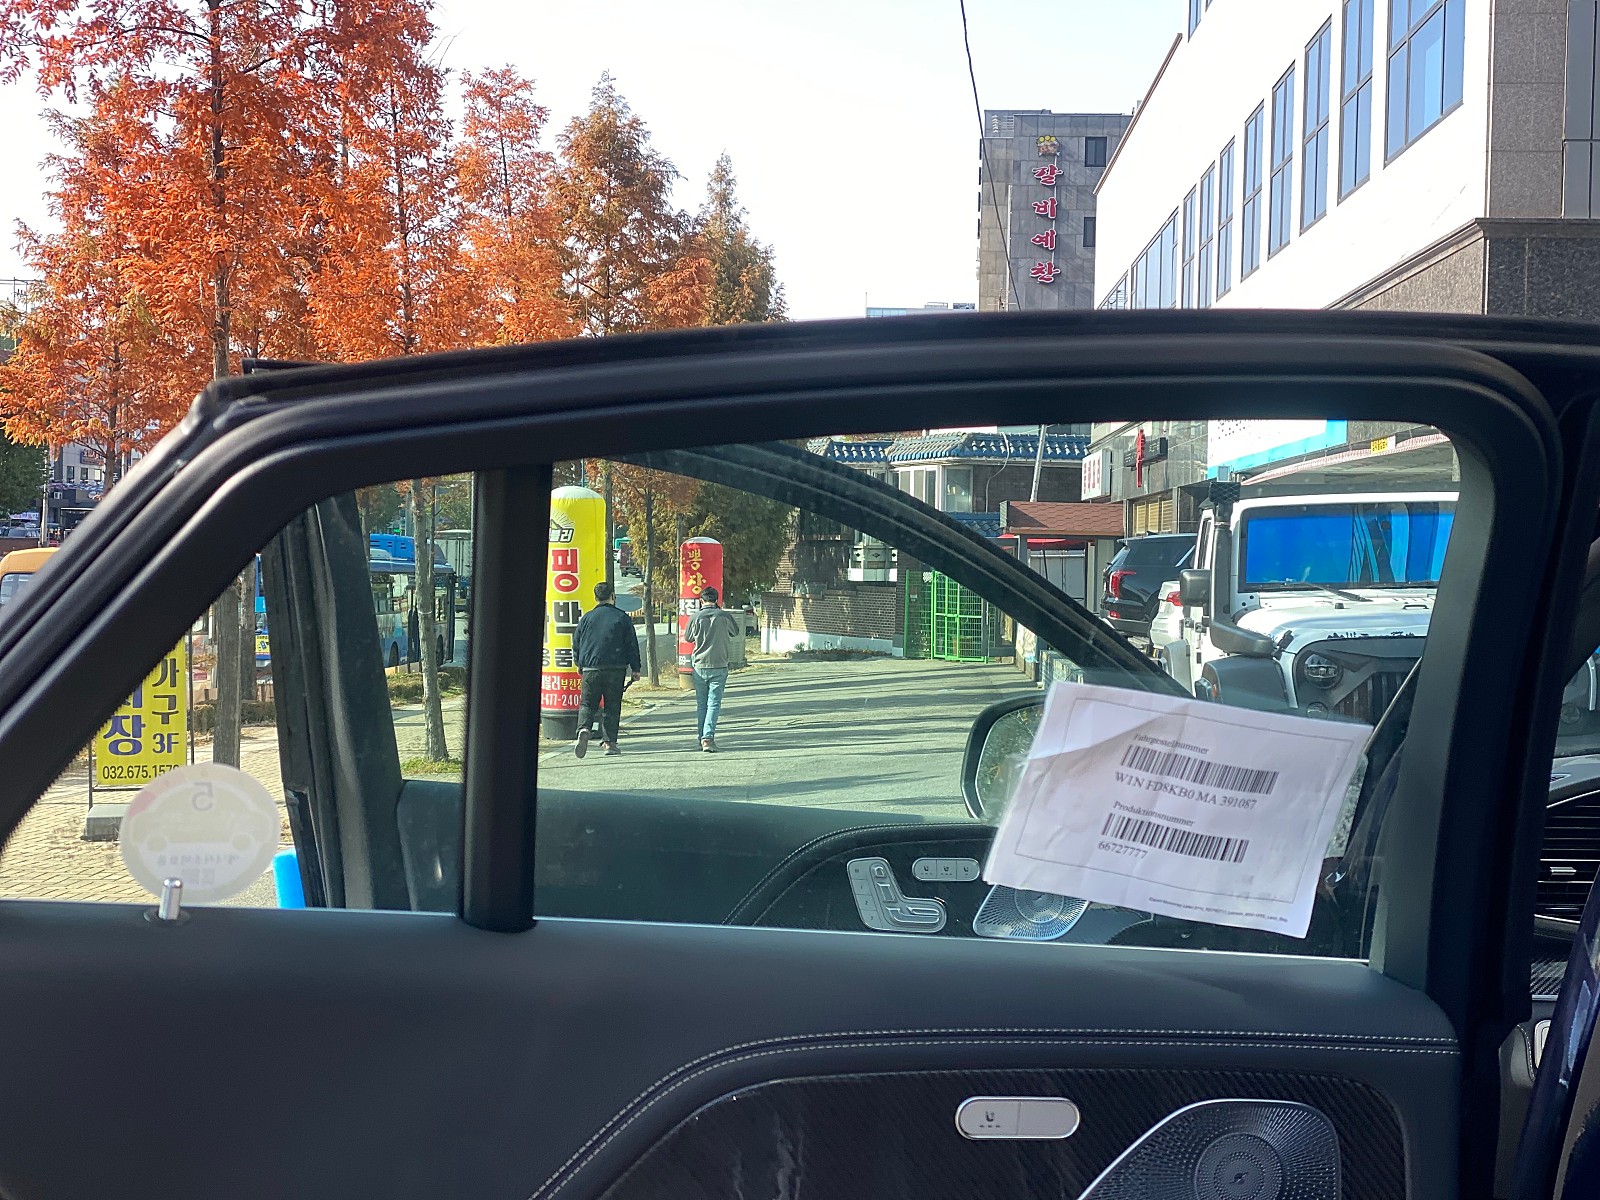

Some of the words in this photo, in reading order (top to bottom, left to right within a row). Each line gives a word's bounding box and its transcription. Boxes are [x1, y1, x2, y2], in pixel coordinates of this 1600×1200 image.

[541, 693, 582, 707] -677-240
[152, 732, 180, 754] 3F
[102, 764, 180, 780] 032.675.157
[1195, 790, 1217, 805] MA
[1112, 800, 1196, 827] Produktionsnummer
